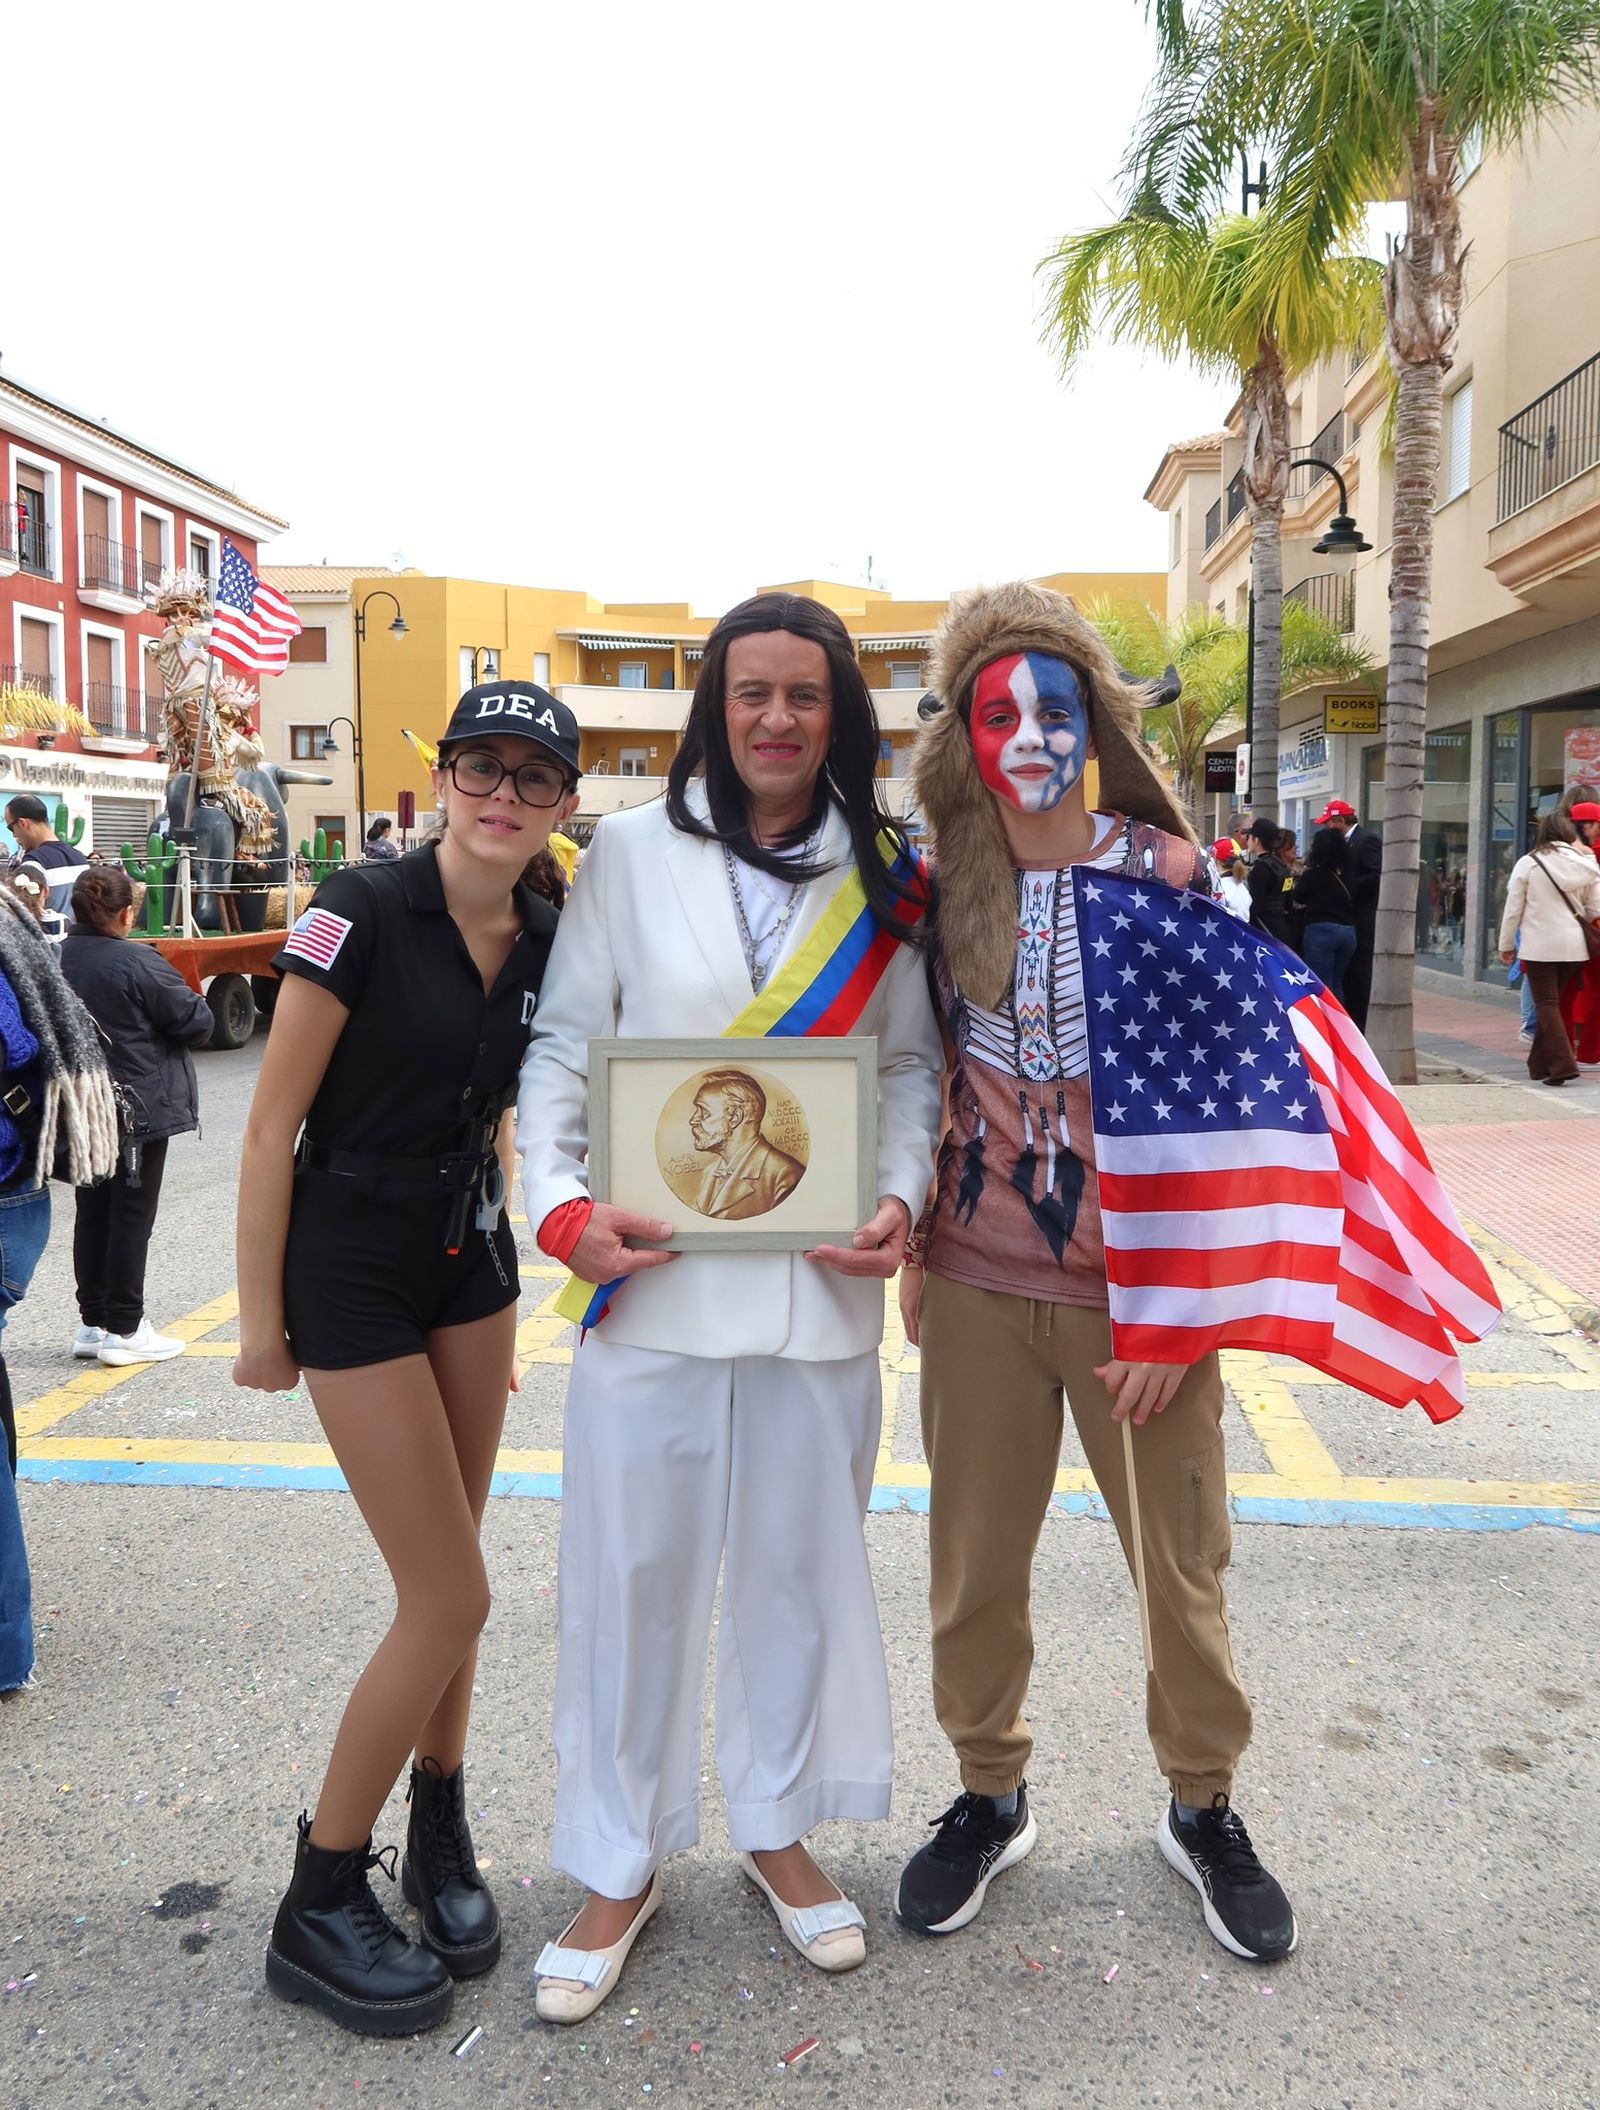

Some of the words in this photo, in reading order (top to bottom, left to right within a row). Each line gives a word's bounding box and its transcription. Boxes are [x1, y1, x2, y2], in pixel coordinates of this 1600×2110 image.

[1332, 700, 1376, 709] BOOKS
[475, 694, 560, 736] DEA
[1208, 765, 1236, 773] AUDITIV
[663, 1161, 705, 1176] NOBEL
